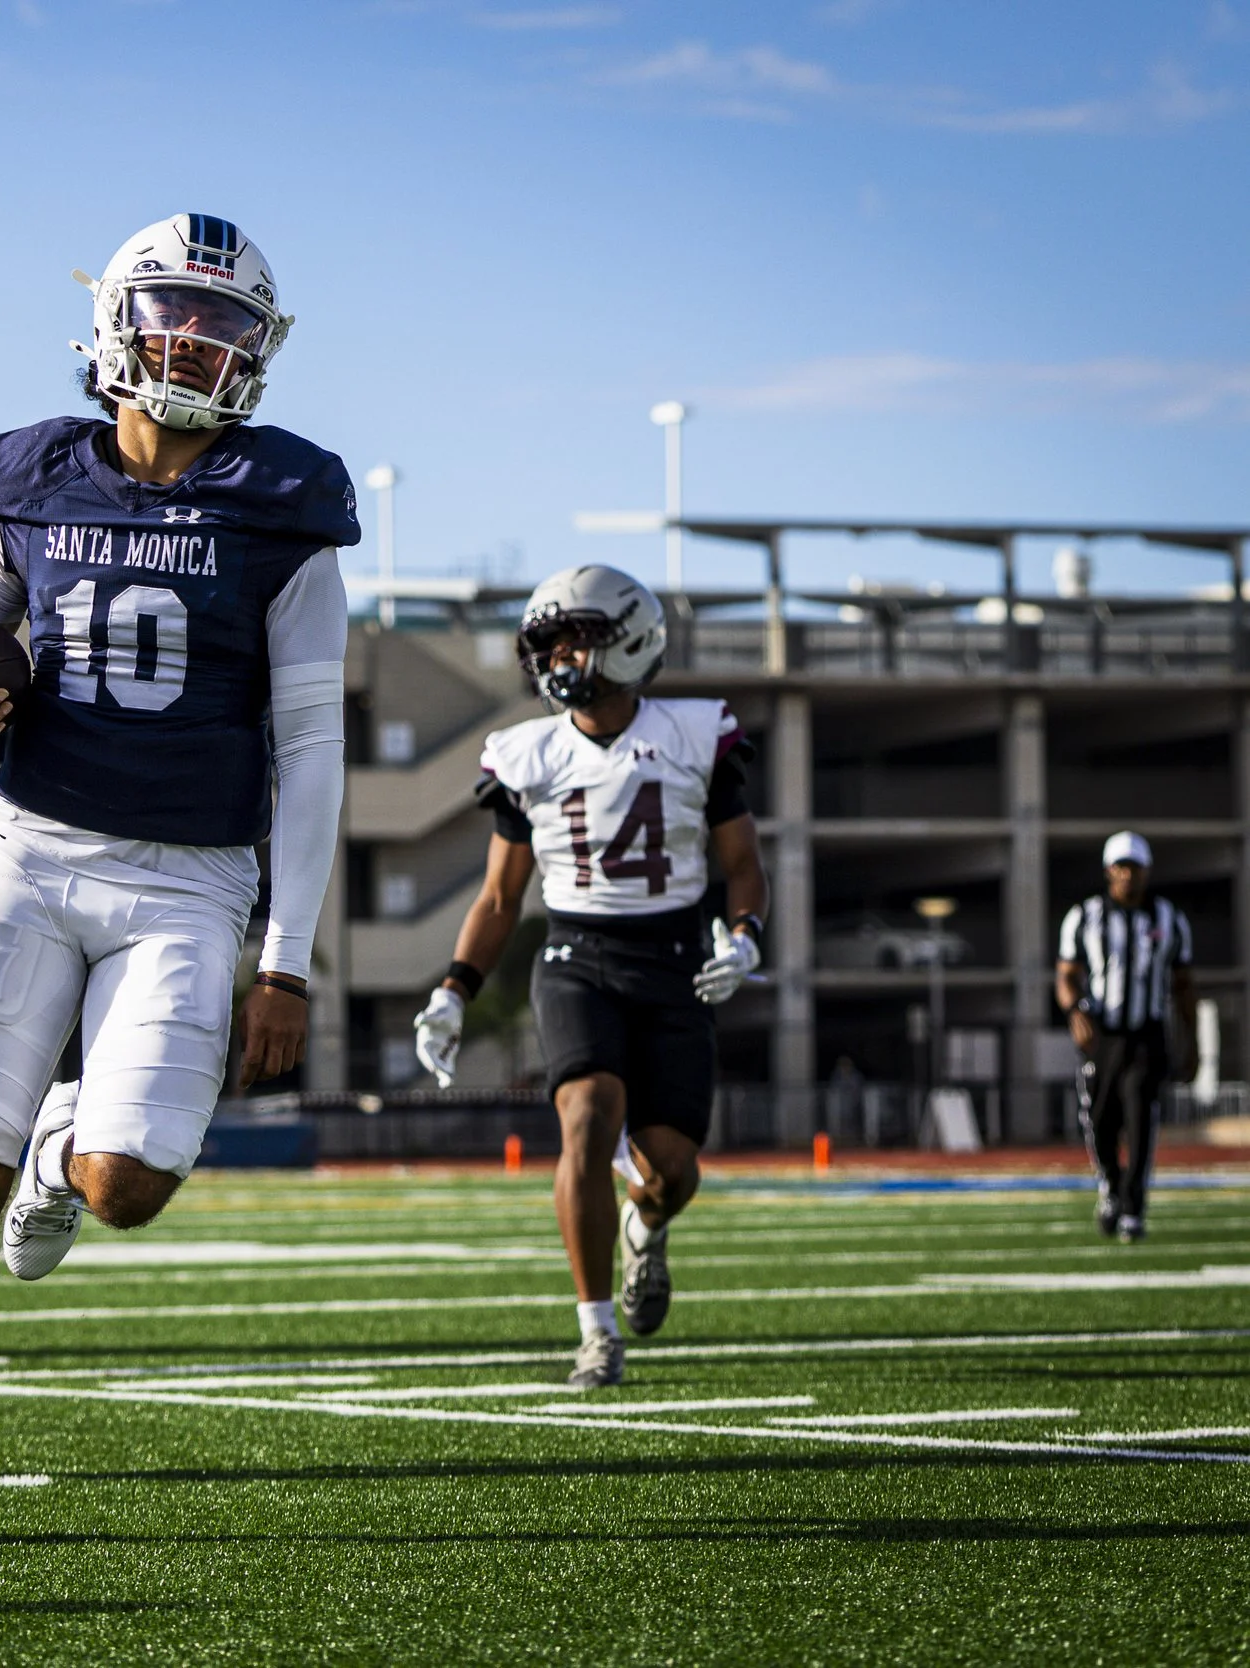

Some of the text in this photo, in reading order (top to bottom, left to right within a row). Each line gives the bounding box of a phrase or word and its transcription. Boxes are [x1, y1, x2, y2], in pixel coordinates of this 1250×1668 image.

[186, 261, 235, 281] Riddell
[170, 390, 196, 402] Riddell
[45, 525, 218, 576] SANTA MONICA
[56, 579, 188, 711] 10
[561, 780, 672, 896] 14
